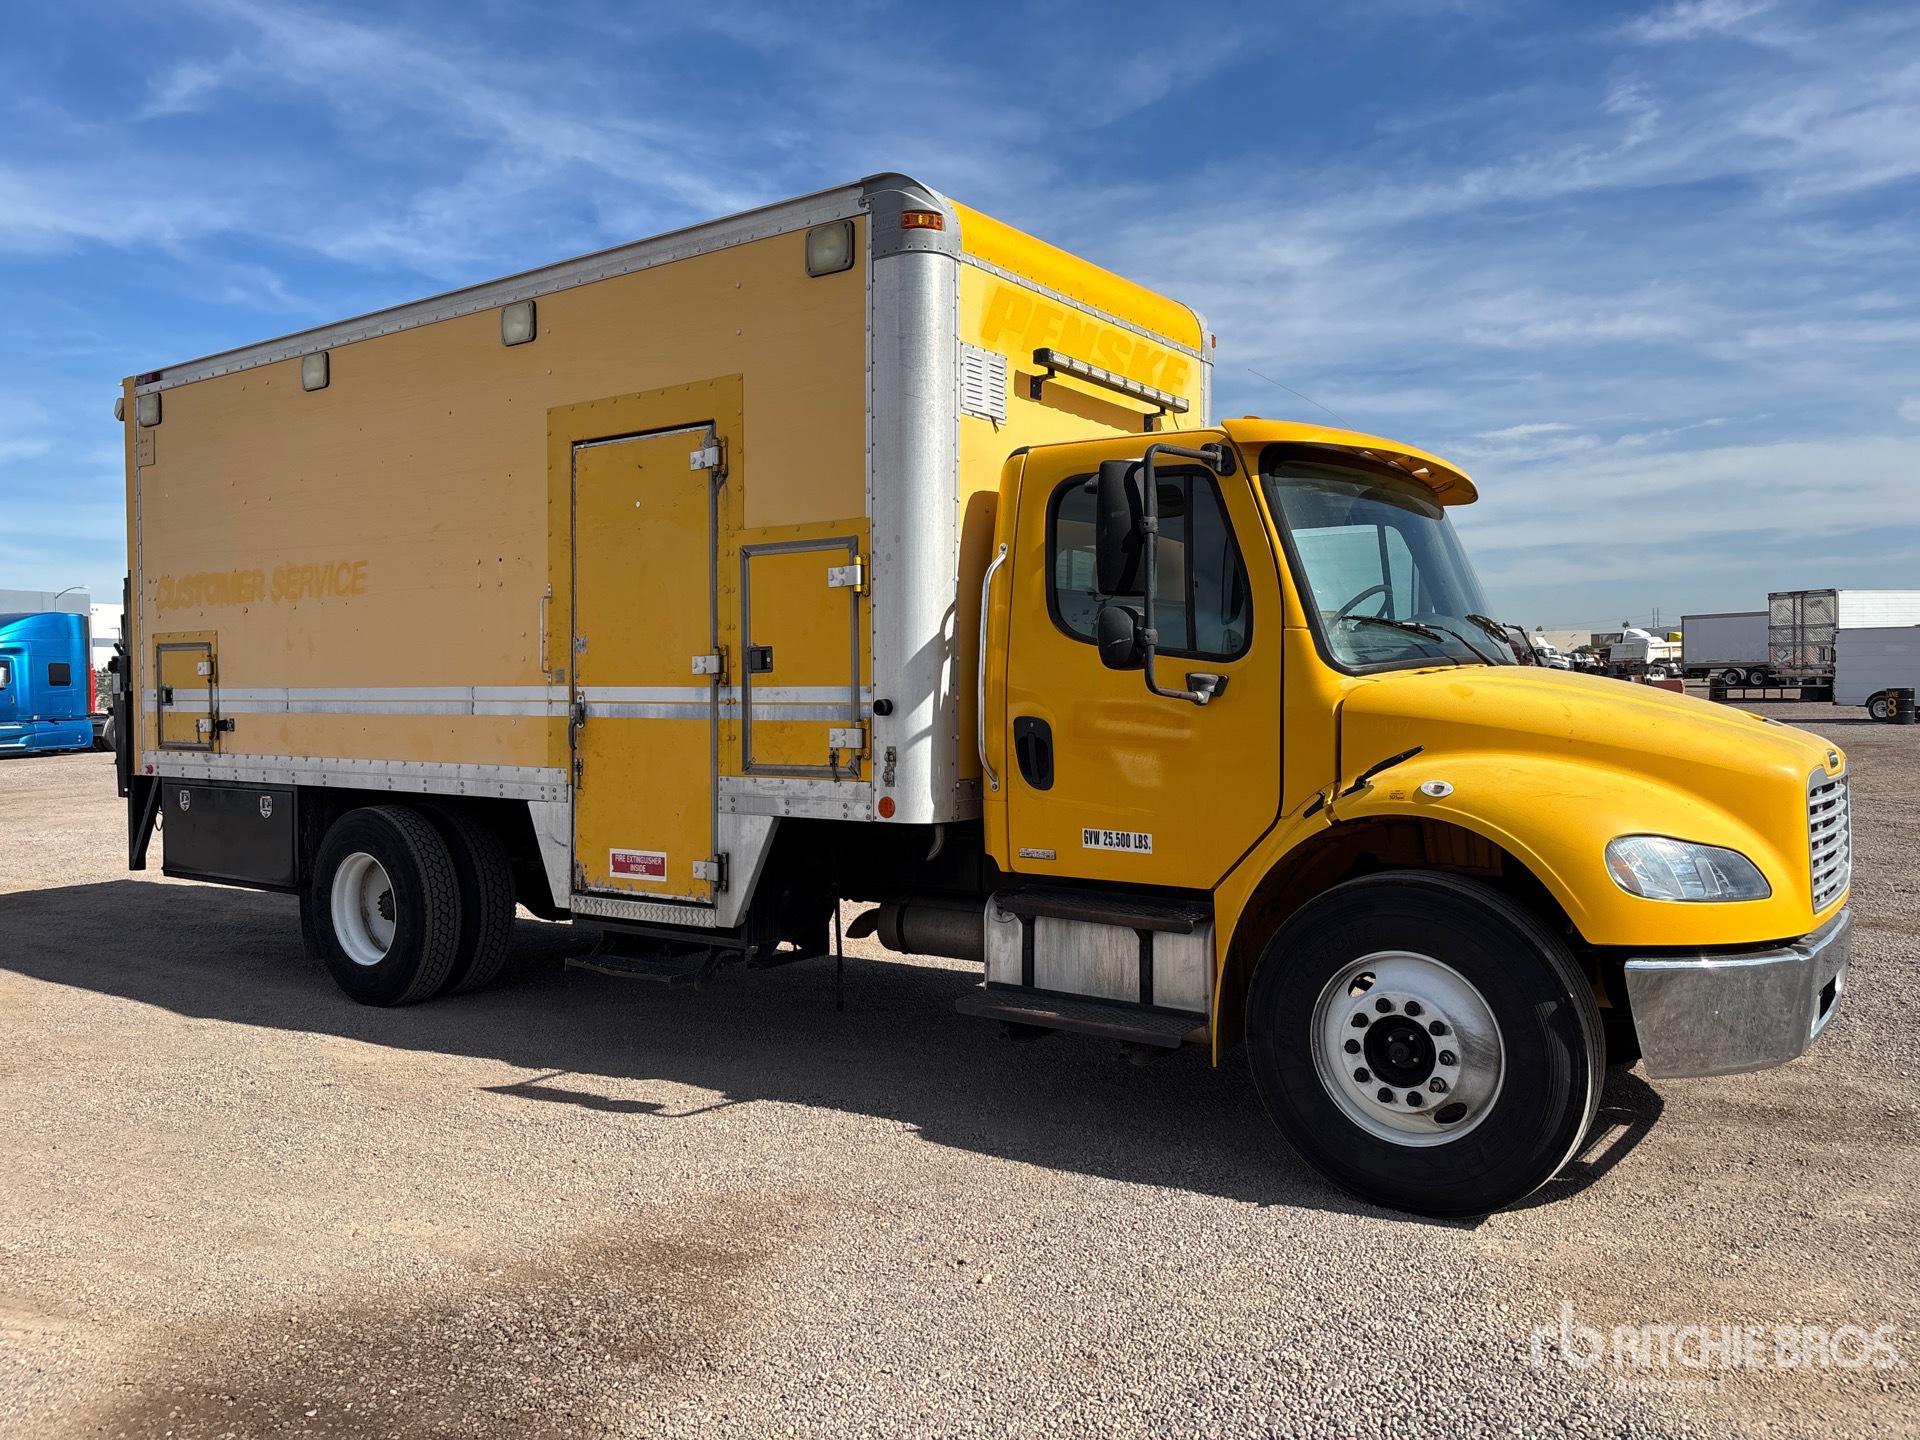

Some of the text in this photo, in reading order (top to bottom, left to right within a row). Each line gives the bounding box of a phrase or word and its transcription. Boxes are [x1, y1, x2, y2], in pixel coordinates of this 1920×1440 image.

[980, 286, 1189, 397] PENSKE
[156, 560, 368, 611] CUSTOMER SERVICE
[1887, 697, 1897, 717] 8
[1084, 830, 1151, 849] GVW 25,500 LBS.
[627, 856, 661, 865] EXTINGUISHER
